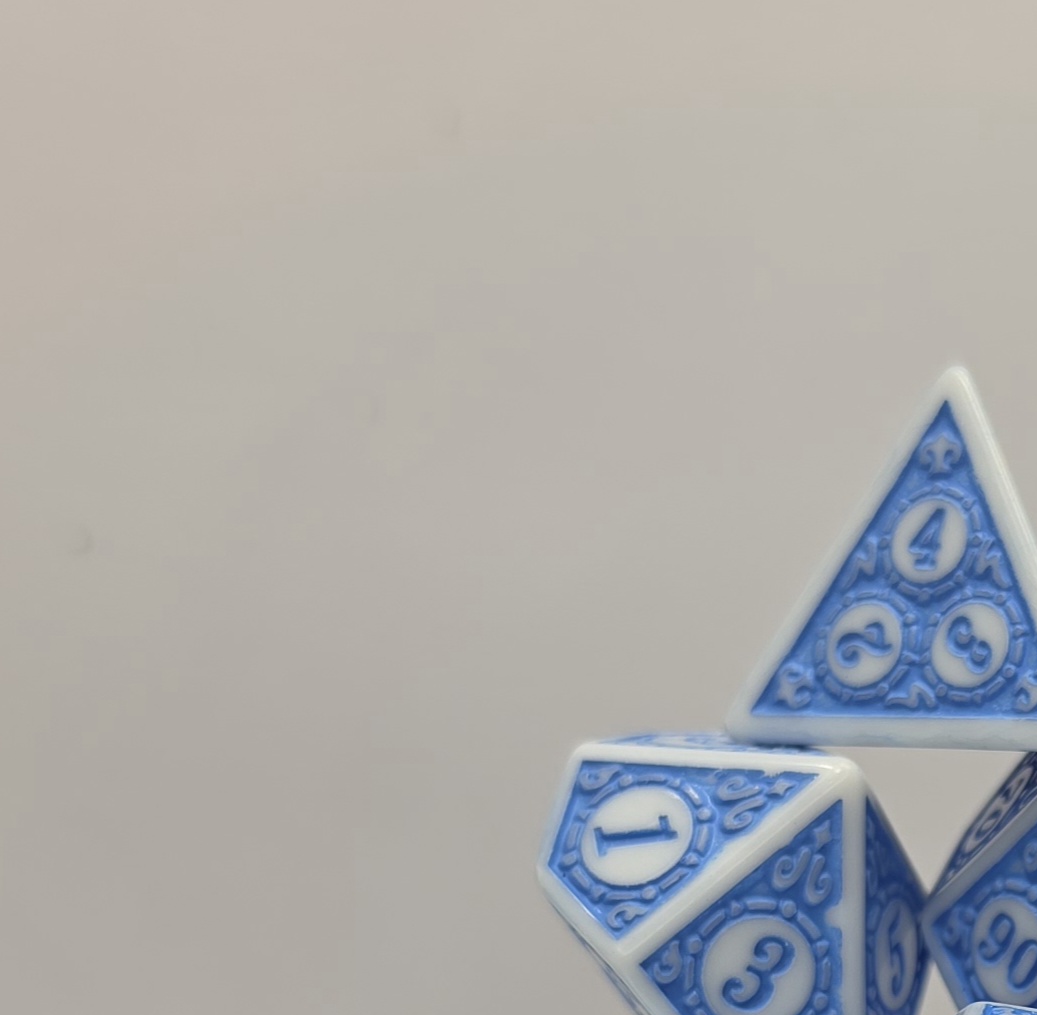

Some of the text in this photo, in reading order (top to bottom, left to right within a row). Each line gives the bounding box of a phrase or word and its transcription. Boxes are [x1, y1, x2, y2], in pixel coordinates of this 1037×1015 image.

[908, 507, 947, 572] 4
[835, 620, 892, 669] 2
[593, 814, 678, 856] 1
[721, 935, 796, 1011] 3
